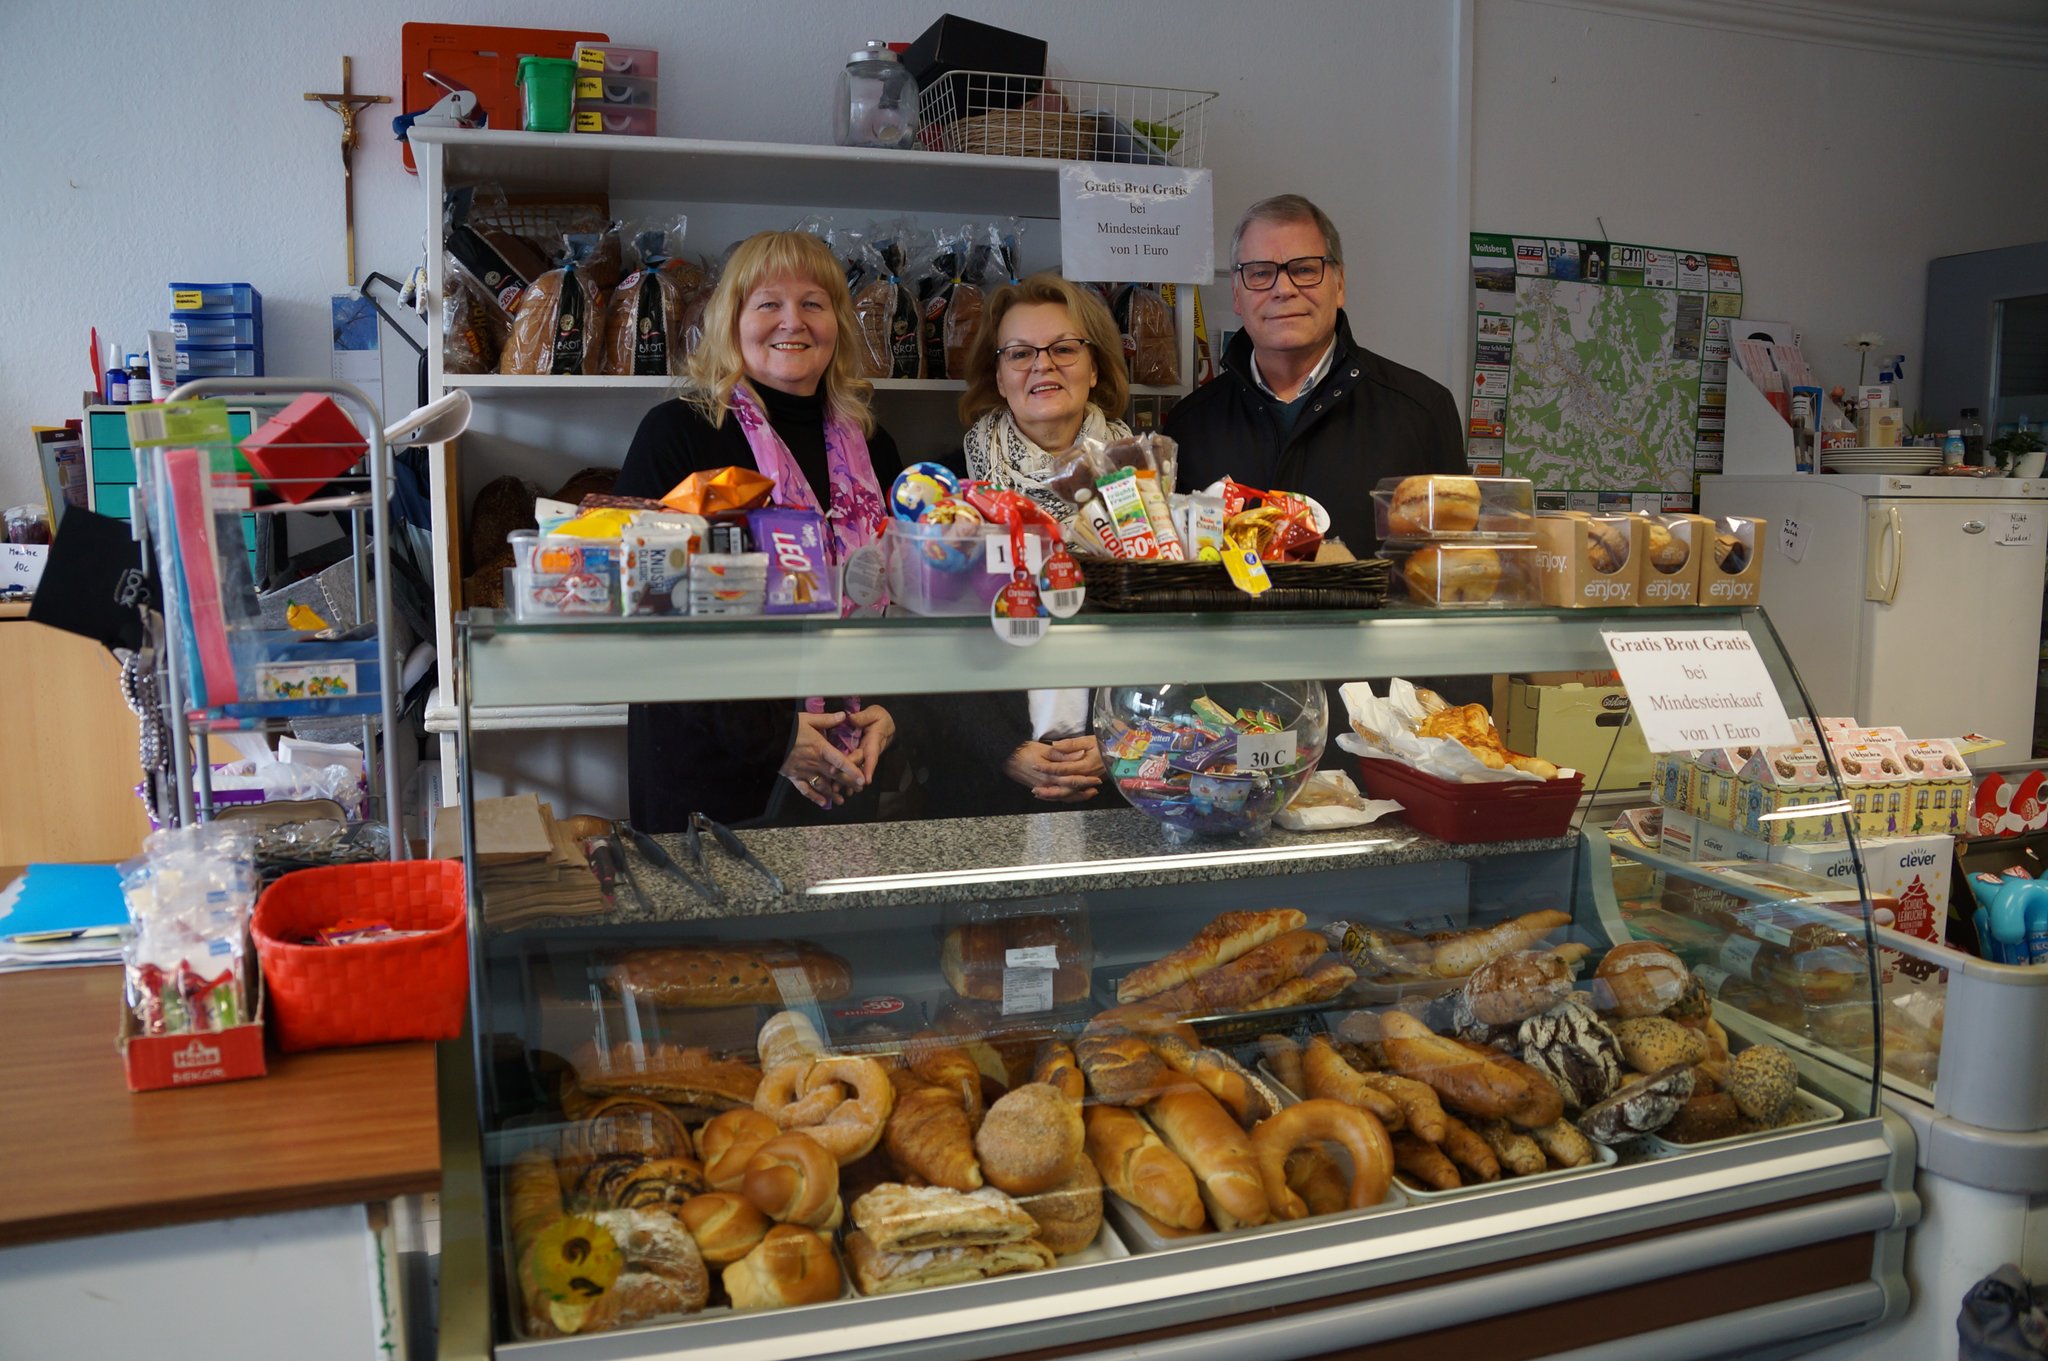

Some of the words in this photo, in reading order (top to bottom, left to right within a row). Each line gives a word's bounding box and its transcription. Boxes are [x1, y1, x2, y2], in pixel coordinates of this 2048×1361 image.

[1084, 180, 1121, 194] Gratis
[1124, 182, 1150, 194] Brot
[1152, 183, 1188, 196] Gratis
[1129, 202, 1147, 215] bei
[1097, 222, 1181, 236] Mindesteinkauf
[1110, 246, 1130, 255] von
[1133, 244, 1139, 255] 1
[1143, 244, 1169, 256] Euro
[1475, 243, 1508, 256] Voitsberg
[771, 532, 812, 572] LEO
[1584, 581, 1631, 601] enjoy.
[1646, 582, 1691, 601] enjoy.
[1709, 582, 1753, 601] enjoy.
[1609, 636, 1663, 653] Gratis
[1663, 636, 1701, 652] Brot
[1702, 635, 1752, 652] Gratis
[1681, 664, 1708, 681] bei
[1649, 691, 1765, 712] Mindesteinkauf
[1679, 728, 1709, 742] von
[1712, 724, 1722, 740] 1
[1725, 723, 1761, 740] Euro
[1250, 752, 1270, 768] 30
[1899, 852, 1937, 868] clever
